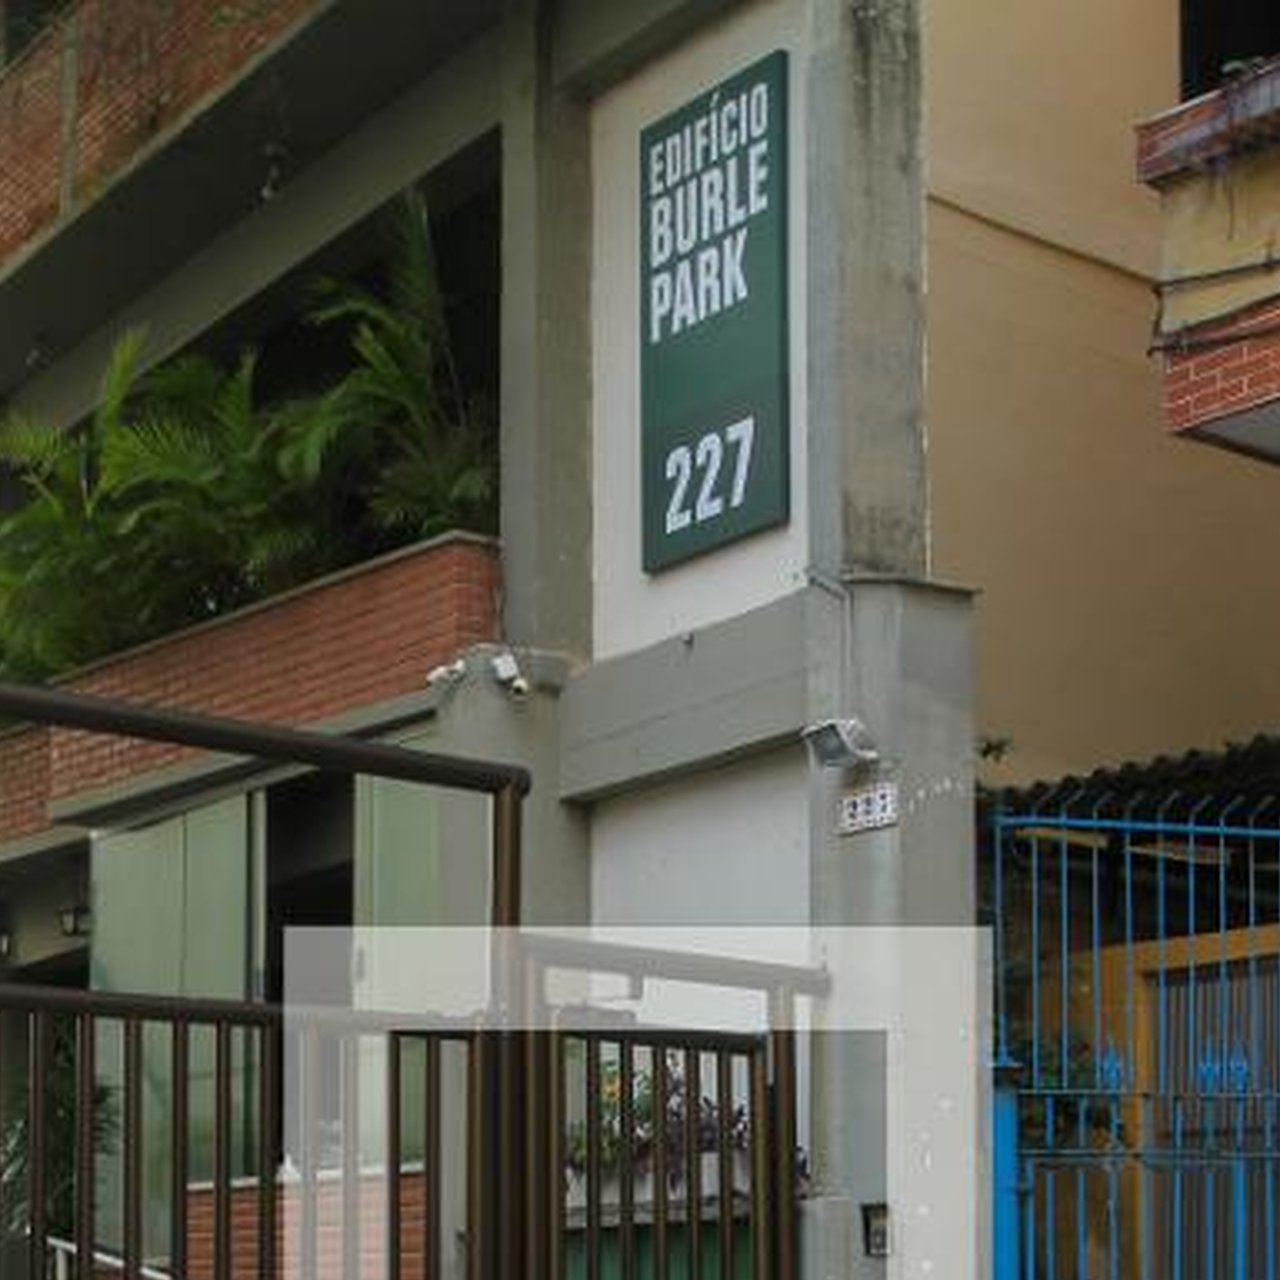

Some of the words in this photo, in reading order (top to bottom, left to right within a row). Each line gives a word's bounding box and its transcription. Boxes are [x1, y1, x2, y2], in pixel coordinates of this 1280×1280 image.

[649, 82, 769, 196] EDIFÍCIO
[650, 140, 769, 269] BURLE
[650, 227, 749, 344] PARK
[665, 415, 755, 535] 227
